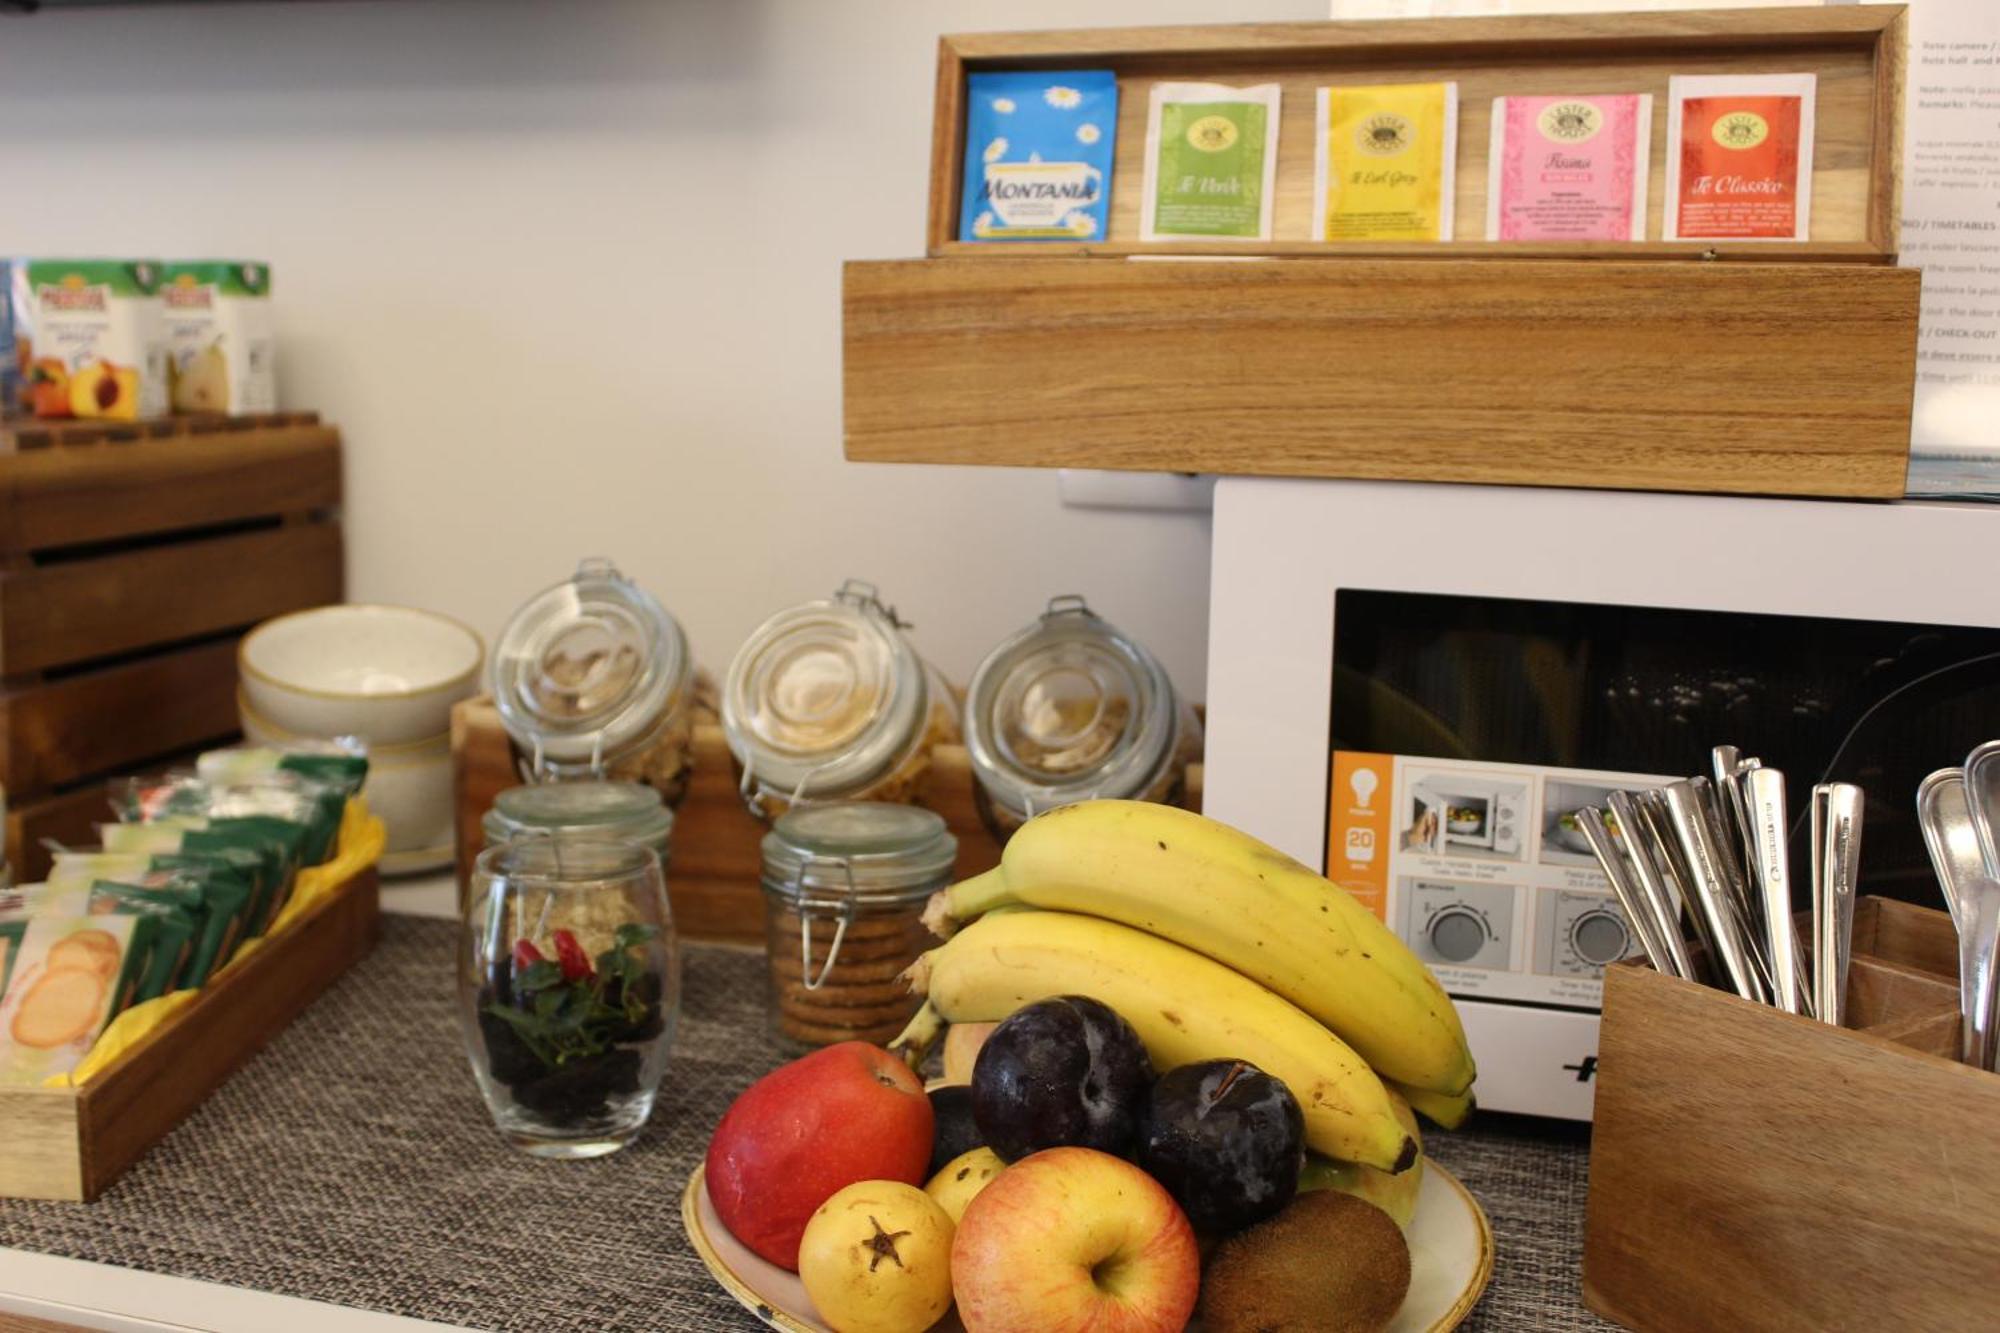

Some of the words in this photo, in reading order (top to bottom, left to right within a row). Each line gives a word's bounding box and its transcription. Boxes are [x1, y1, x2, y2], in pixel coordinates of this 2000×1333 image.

[1930, 219, 1997, 231] TIMETABLES
[1934, 327, 1997, 340] CHECK-OUT
[1348, 831, 1372, 849] 20
